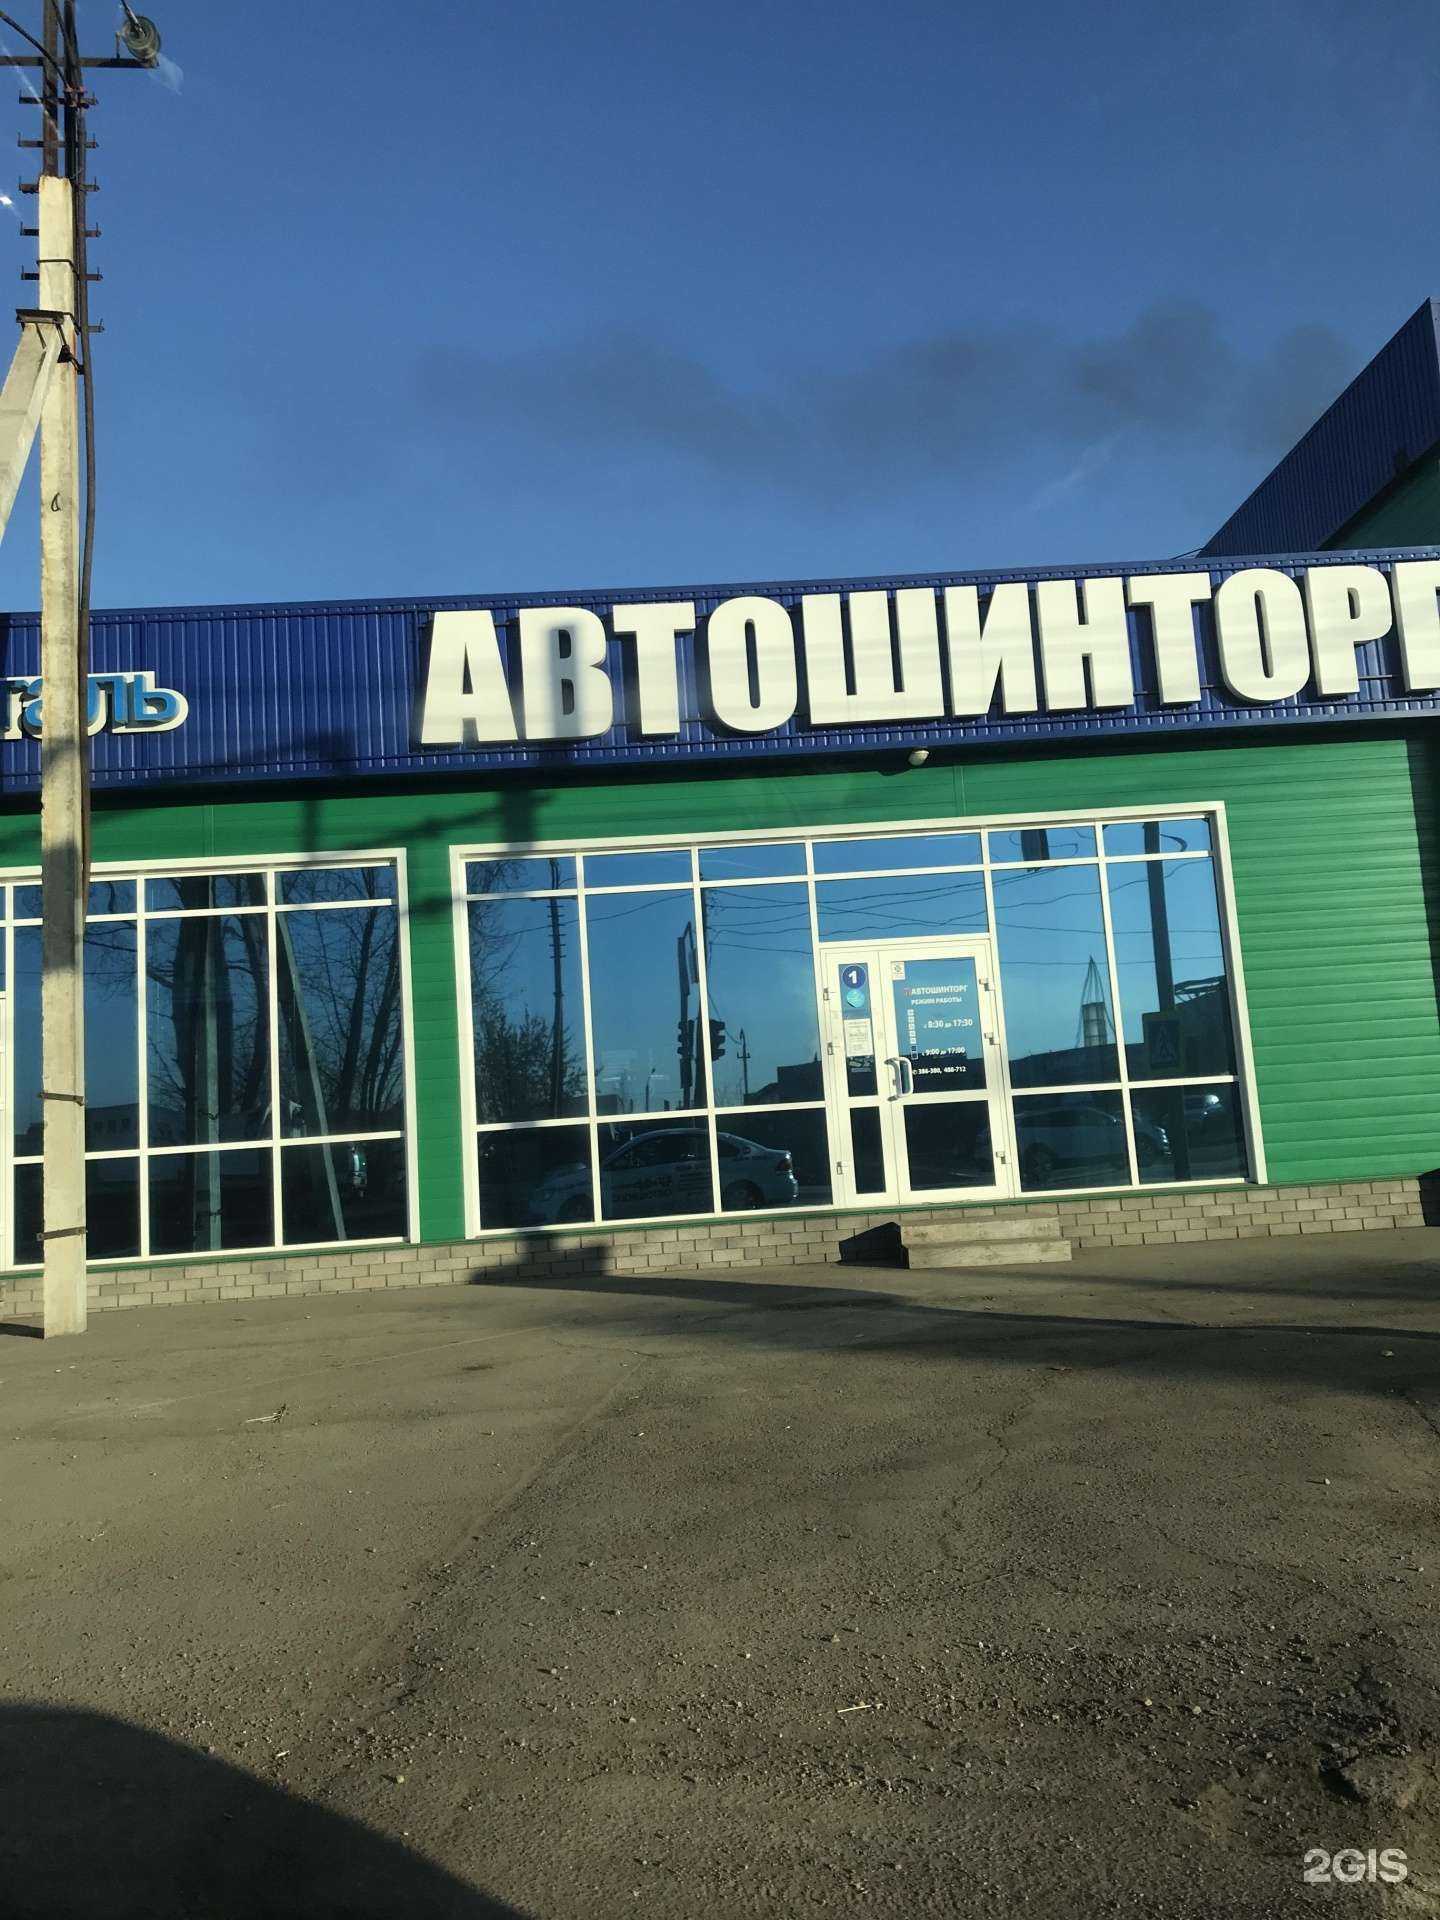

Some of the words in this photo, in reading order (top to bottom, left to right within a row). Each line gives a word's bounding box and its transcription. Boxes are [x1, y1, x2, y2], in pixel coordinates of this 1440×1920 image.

[420, 560, 1440, 746] АВТОШИНТОРГ
[848, 970, 858, 984] 1
[911, 985, 968, 995] АВТОШИНТОРГ
[953, 1018, 973, 1027] 17:30
